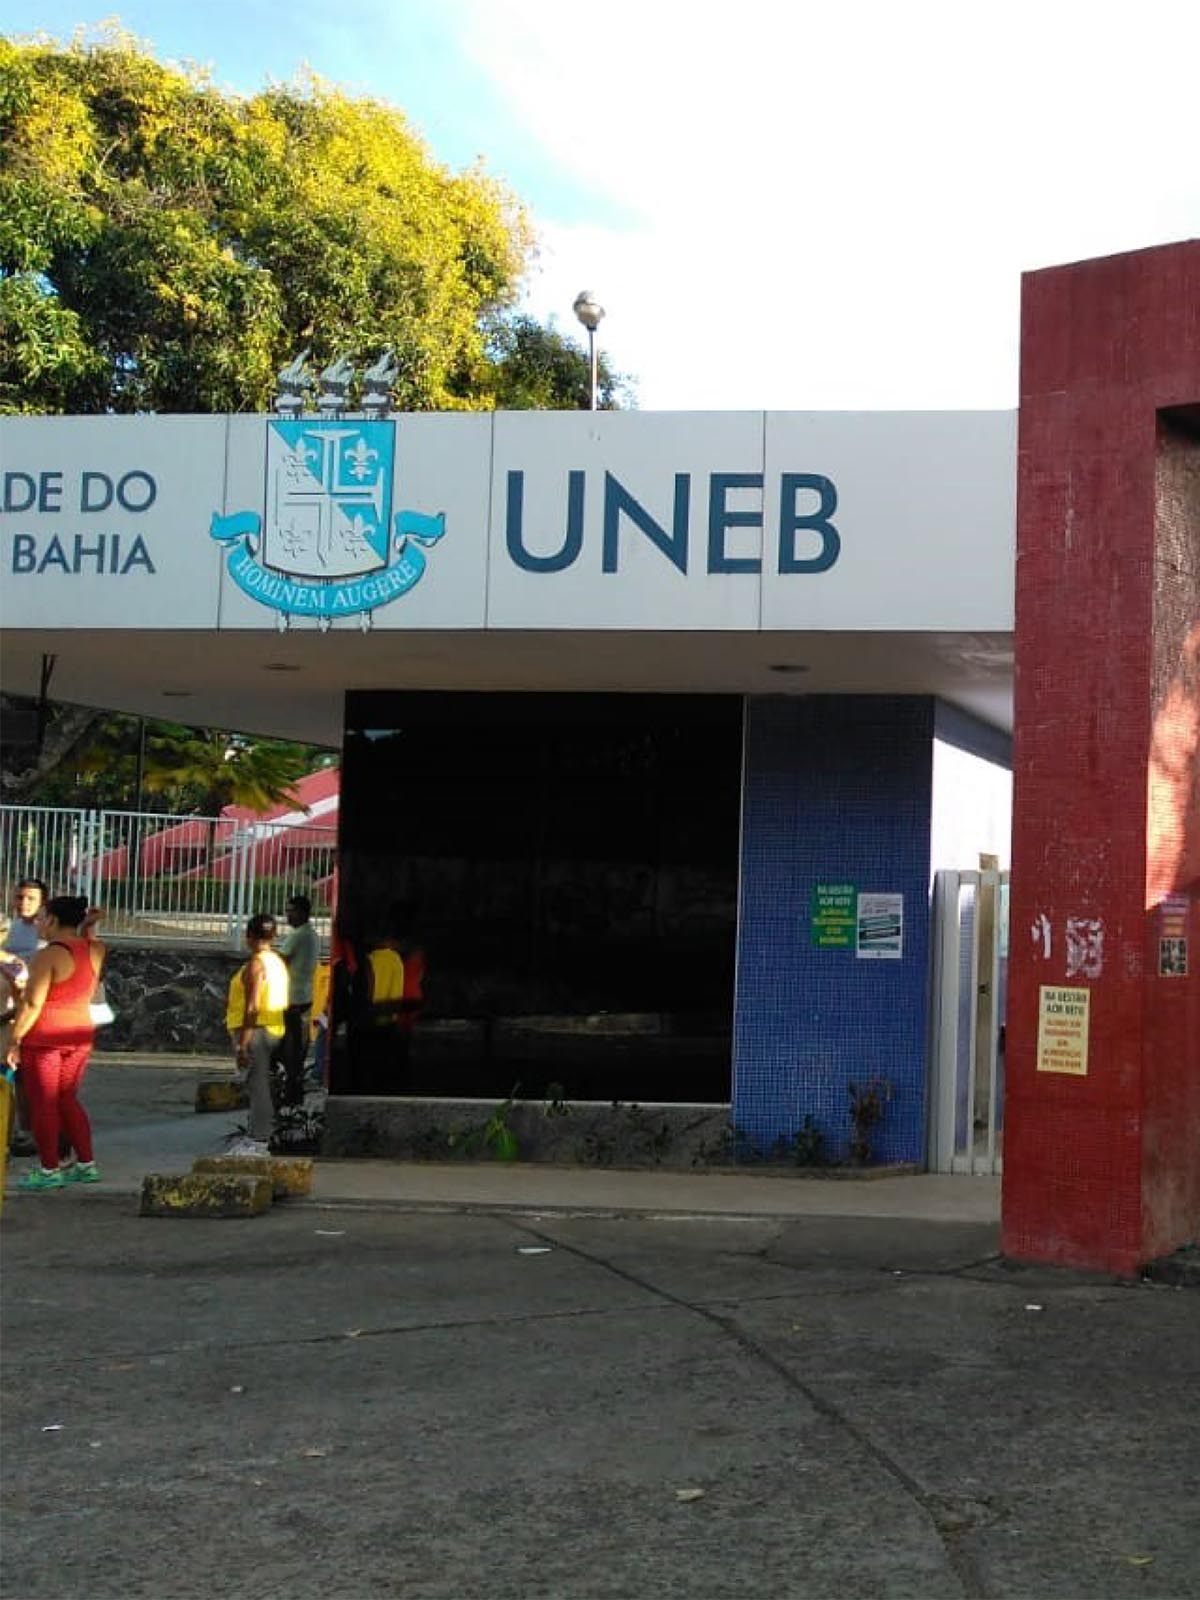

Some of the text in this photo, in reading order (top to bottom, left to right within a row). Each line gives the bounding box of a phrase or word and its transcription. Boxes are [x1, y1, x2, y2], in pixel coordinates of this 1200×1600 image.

[0, 470, 157, 513] DE DO
[506, 469, 841, 576] UNEB
[12, 533, 157, 574] BAHIA
[235, 554, 418, 608] HOMINEM AUGERE
